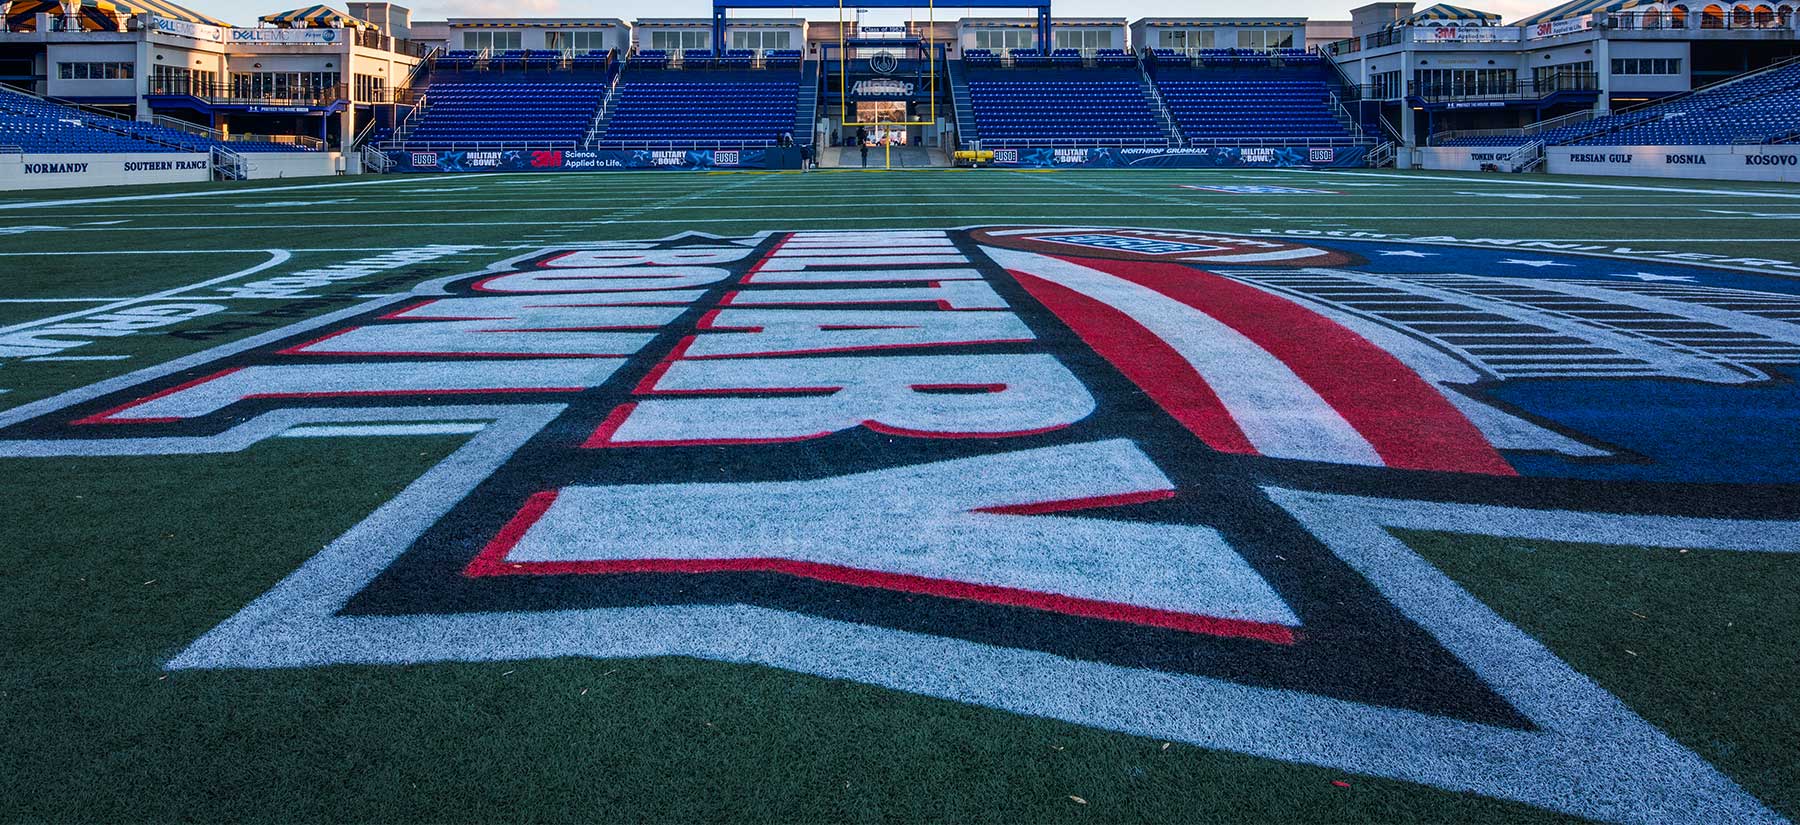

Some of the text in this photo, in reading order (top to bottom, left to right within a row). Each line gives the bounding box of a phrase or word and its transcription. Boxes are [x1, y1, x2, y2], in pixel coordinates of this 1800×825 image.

[1435, 27, 1456, 39] 3M
[1537, 22, 1552, 36] 3M
[233, 30, 290, 40] DELL EMC
[850, 80, 914, 96] Allstate
[467, 151, 502, 160] MILITARY
[565, 150, 597, 159] Science.
[651, 150, 687, 158] MILITARY
[1240, 148, 1275, 156] MILITARY
[1471, 153, 1494, 161] TONKIN
[473, 158, 497, 167] BOWL
[530, 150, 563, 167] 3M
[565, 159, 622, 168] Applied to Life.
[1060, 155, 1083, 163] BOWL
[1570, 153, 1632, 163] PERSIAN GULF
[1666, 154, 1706, 165] BOSNIA
[1745, 154, 1798, 166] KOSOVO
[24, 162, 89, 174] NORMANDY
[124, 160, 207, 171] SOUTHERN FRANCE
[1391, 234, 1800, 270] ANNIVER
[0, 244, 484, 358] NORTHROP GRU
[72, 246, 764, 424] BOWL
[466, 230, 1302, 644] MILITARY
